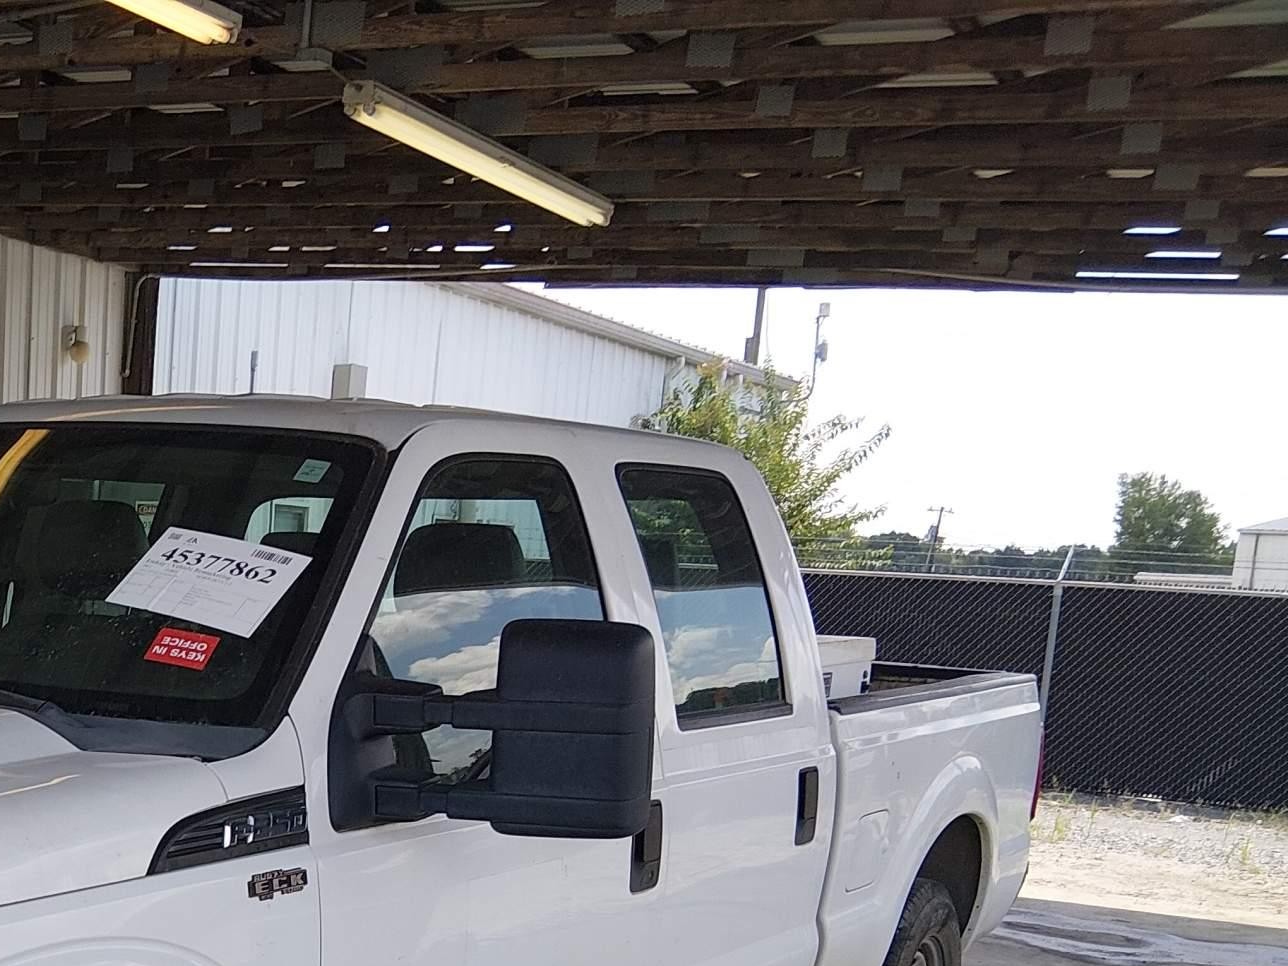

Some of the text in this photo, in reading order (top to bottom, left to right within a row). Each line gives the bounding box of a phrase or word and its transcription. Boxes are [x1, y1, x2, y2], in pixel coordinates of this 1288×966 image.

[161, 546, 277, 584] 45377862
[160, 636, 208, 651] OFFICE
[152, 645, 207, 662] KEYS IN
